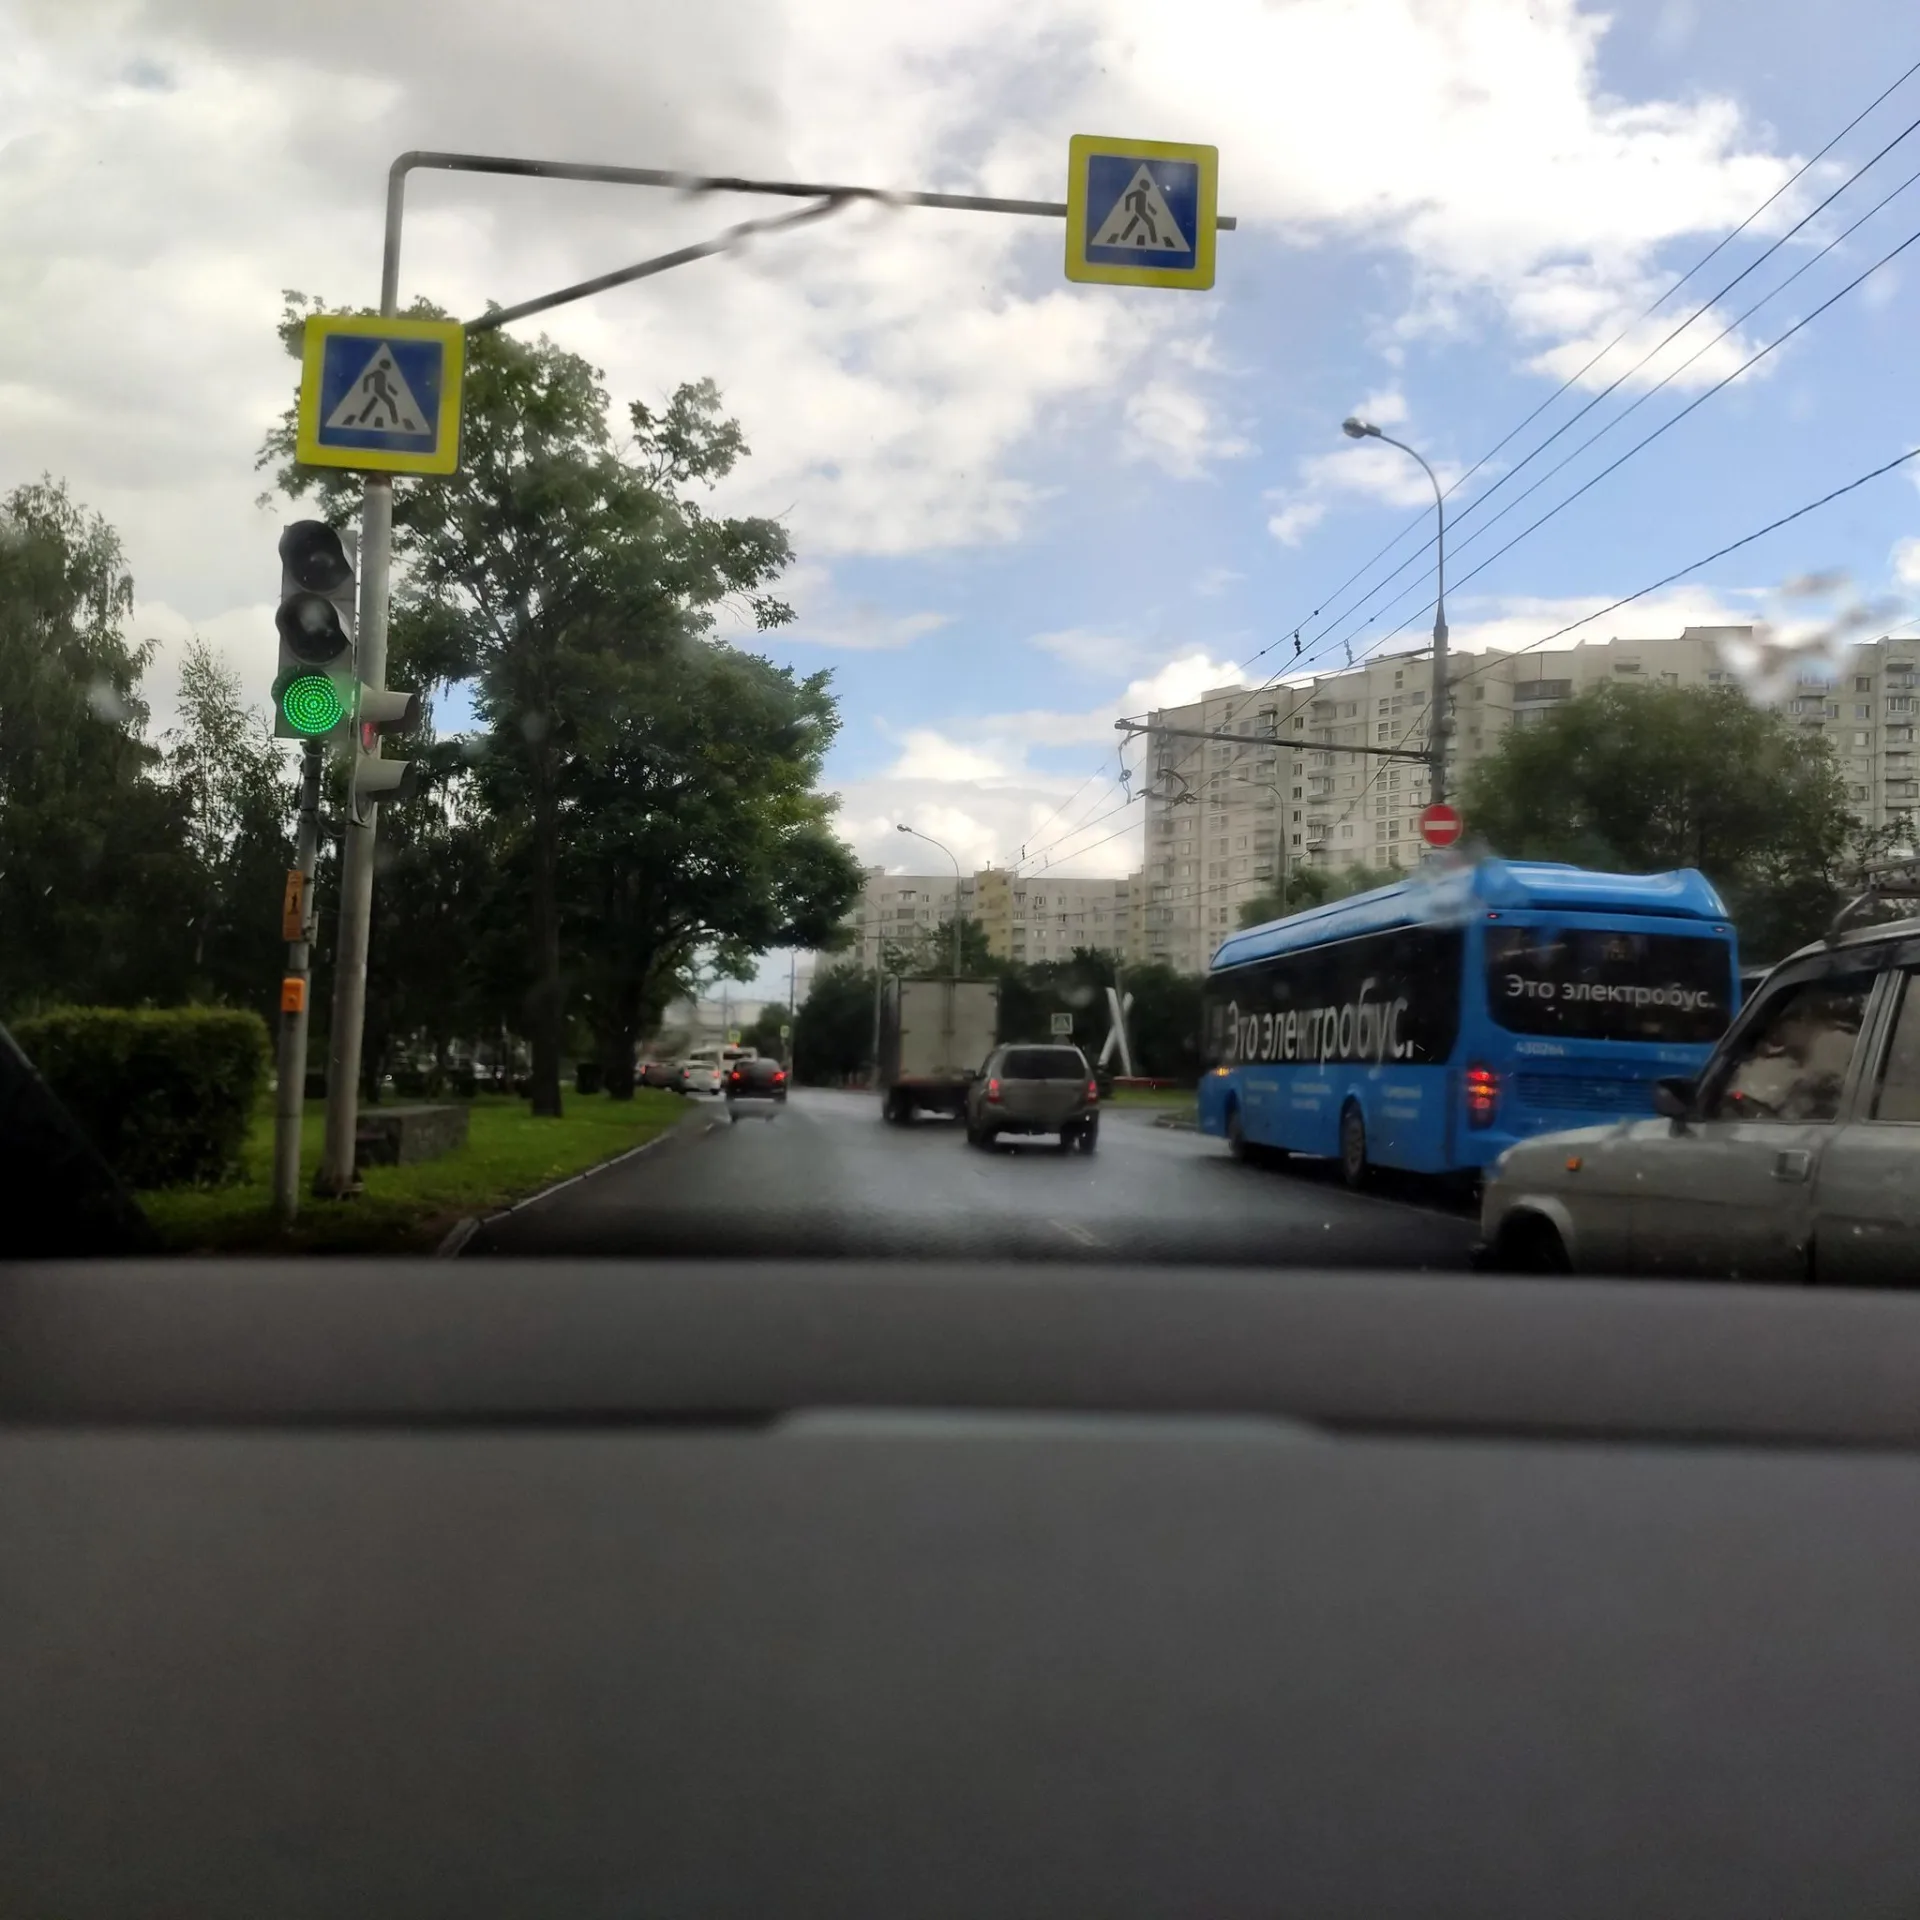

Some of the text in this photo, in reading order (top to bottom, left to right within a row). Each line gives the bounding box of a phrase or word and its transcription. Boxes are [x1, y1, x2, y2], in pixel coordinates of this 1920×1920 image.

[1505, 974, 1716, 1012] Это электробус.
[1228, 1000, 1259, 1061] Это
